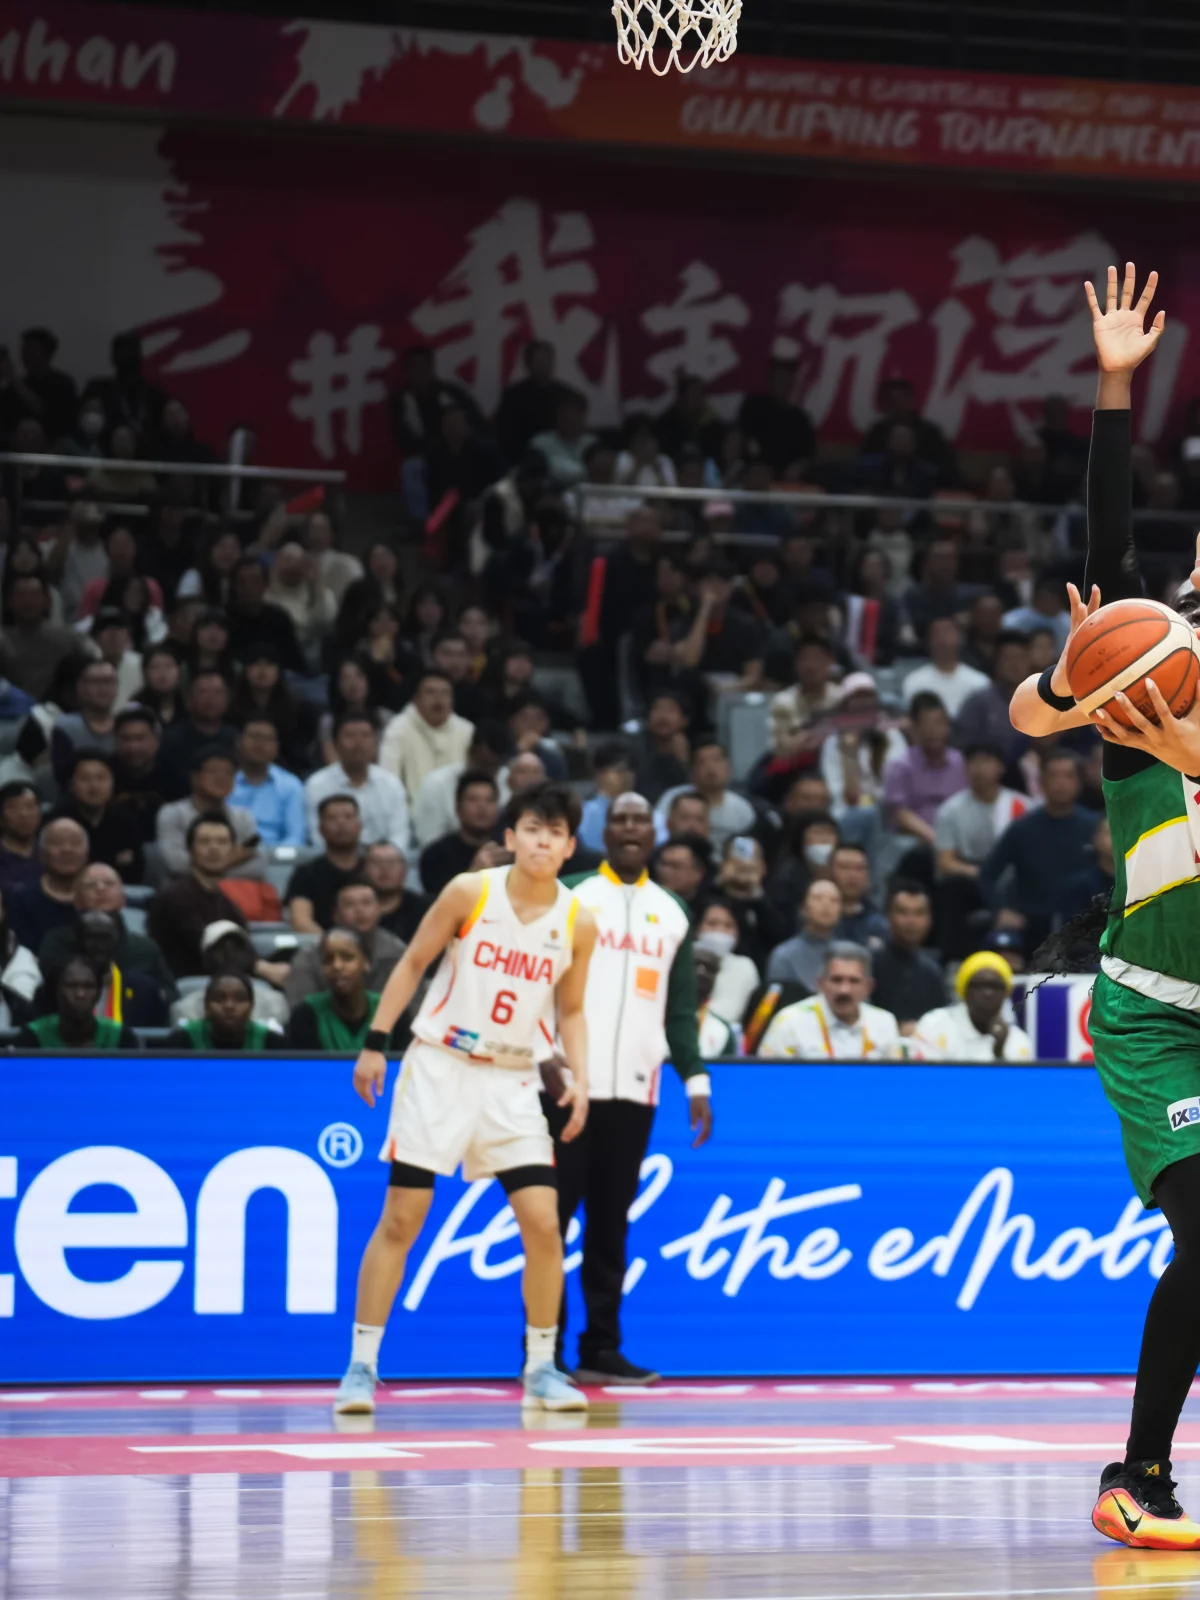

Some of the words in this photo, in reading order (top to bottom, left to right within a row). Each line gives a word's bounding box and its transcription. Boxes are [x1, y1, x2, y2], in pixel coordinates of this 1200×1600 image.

[681, 95, 920, 148] QUALIFYING
[473, 940, 555, 985] CHINA
[598, 928, 664, 959] MALI
[490, 989, 518, 1025] 6
[660, 1177, 863, 1298] the
